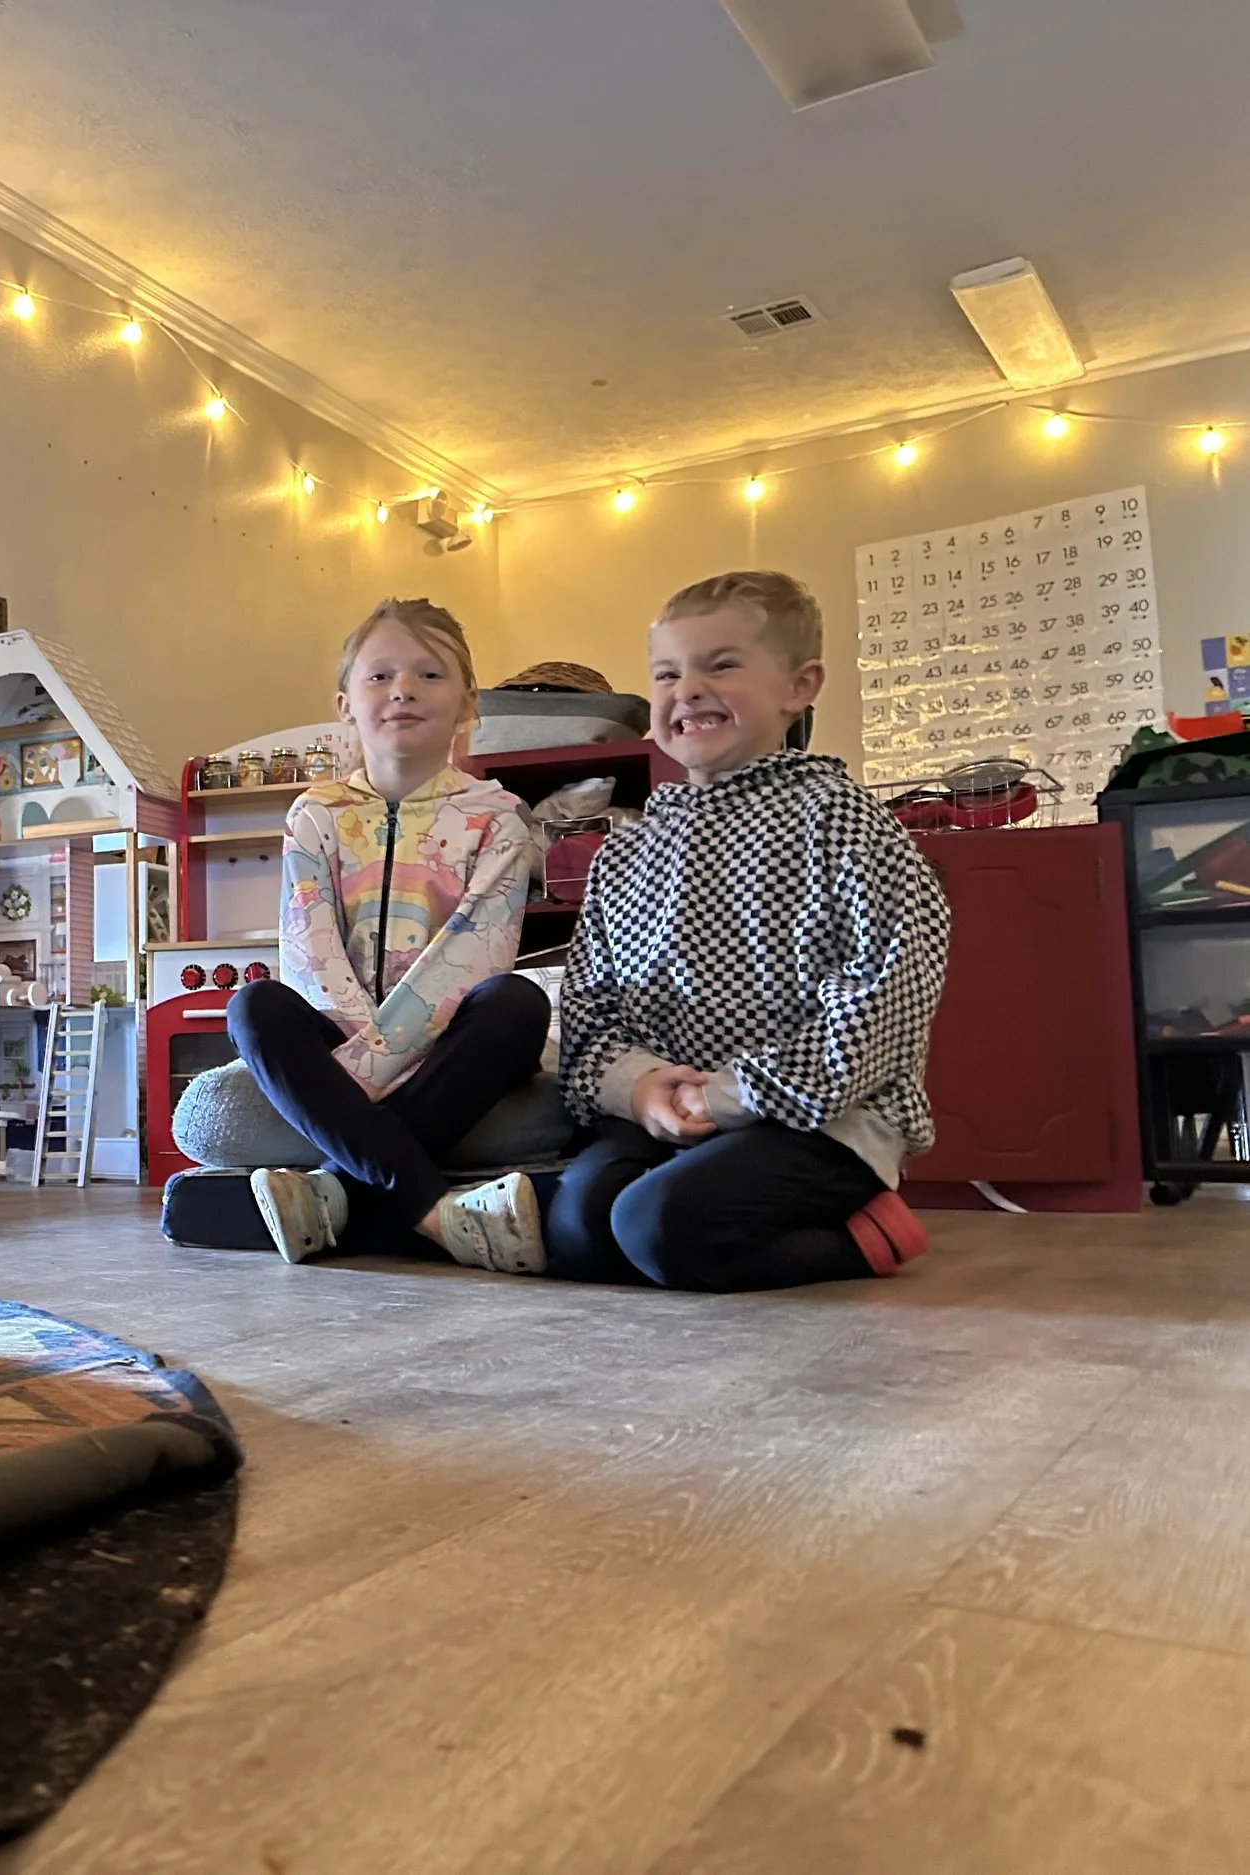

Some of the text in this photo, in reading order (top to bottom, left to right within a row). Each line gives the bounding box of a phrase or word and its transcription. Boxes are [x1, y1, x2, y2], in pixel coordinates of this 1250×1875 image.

[869, 498, 1138, 566] 1 2 3 4 5 6 7 8 9 10
[868, 530, 1142, 592] 11 12 13 14 15 16 17 18 19 20
[867, 567, 1146, 627] 21 22 23 24 25 26 27 28 29 30
[869, 599, 1149, 655] 31 32 33 34 35 36 37 38 39 40
[870, 637, 1152, 688] 41 42 43 44 45 46 47 48 49 50
[871, 705, 884, 717] 51
[952, 698, 969, 710] 54
[986, 691, 1003, 703] 55
[1010, 687, 1030, 700] 56
[1043, 685, 1062, 699] 57
[1070, 682, 1088, 695] 58
[1106, 673, 1124, 687] 59
[1133, 670, 1153, 684] 60
[927, 730, 944, 741] 63
[954, 727, 971, 739] 64
[1013, 724, 1031, 735] 66
[1045, 715, 1064, 729] 67
[1072, 713, 1090, 726] 68
[1108, 711, 1126, 724] 69
[1136, 708, 1155, 721] 70
[1048, 752, 1065, 765] 77
[1075, 750, 1091, 763] 78
[1076, 782, 1094, 795] 88
